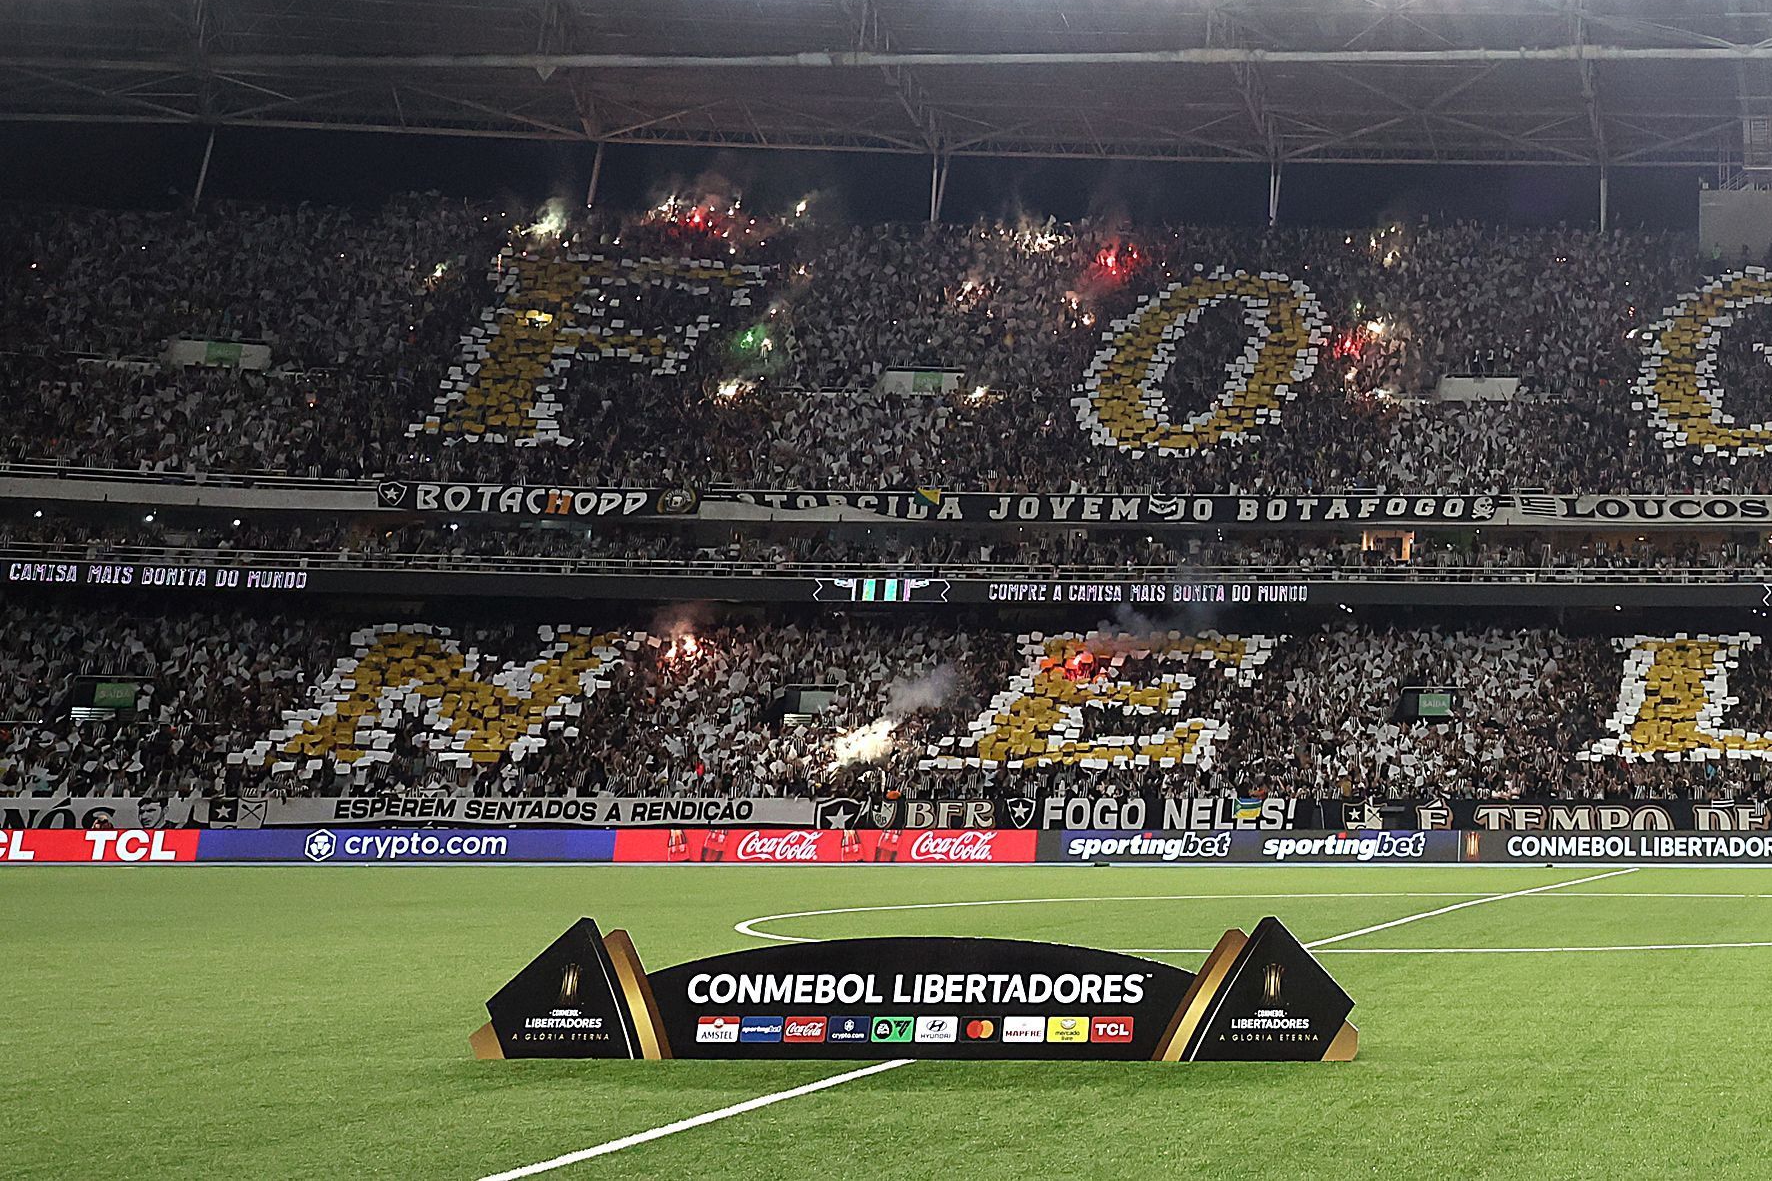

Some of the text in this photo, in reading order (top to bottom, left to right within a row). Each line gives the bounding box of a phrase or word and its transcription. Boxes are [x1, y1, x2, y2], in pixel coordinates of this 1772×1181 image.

[416, 484, 647, 515] BOTACHOPP
[989, 497, 1141, 520] JOVEM
[1237, 497, 1465, 521] BOTAFOGO
[1559, 497, 1770, 518] LOUCOS
[9, 563, 307, 589] CAMISA MAIS BONITA DO MUNDO
[988, 583, 1308, 602] COMPRE A CAMISA MAIS BONITA DO MUNDO
[334, 798, 457, 819] ESPEREM
[464, 799, 597, 821] SENTADOS
[604, 801, 622, 822] A
[905, 800, 995, 829] BFR
[1043, 798, 1145, 830] FOGO
[1475, 806, 1673, 830] TEMPO
[1696, 806, 1772, 830] DE
[85, 831, 177, 861] TCL
[344, 832, 507, 859] crypto.com
[737, 831, 824, 860] Coca-Cola
[911, 831, 998, 860] Coca-Cola
[1068, 832, 1232, 861] sportingbet
[1263, 832, 1426, 861] sportingbet
[1507, 836, 1637, 857] CONMEBOL
[687, 973, 1147, 1003] CONMEBOL LIBERTADORES
[525, 1018, 602, 1028] LIBERTADORES
[701, 1031, 733, 1039] AMSTEL
[1095, 1023, 1130, 1036] TCL
[1231, 1018, 1310, 1029] LIBERTADORES
[512, 1033, 518, 1041] A
[571, 1033, 610, 1041] ETERNA
[831, 1032, 865, 1040] crypto.com
